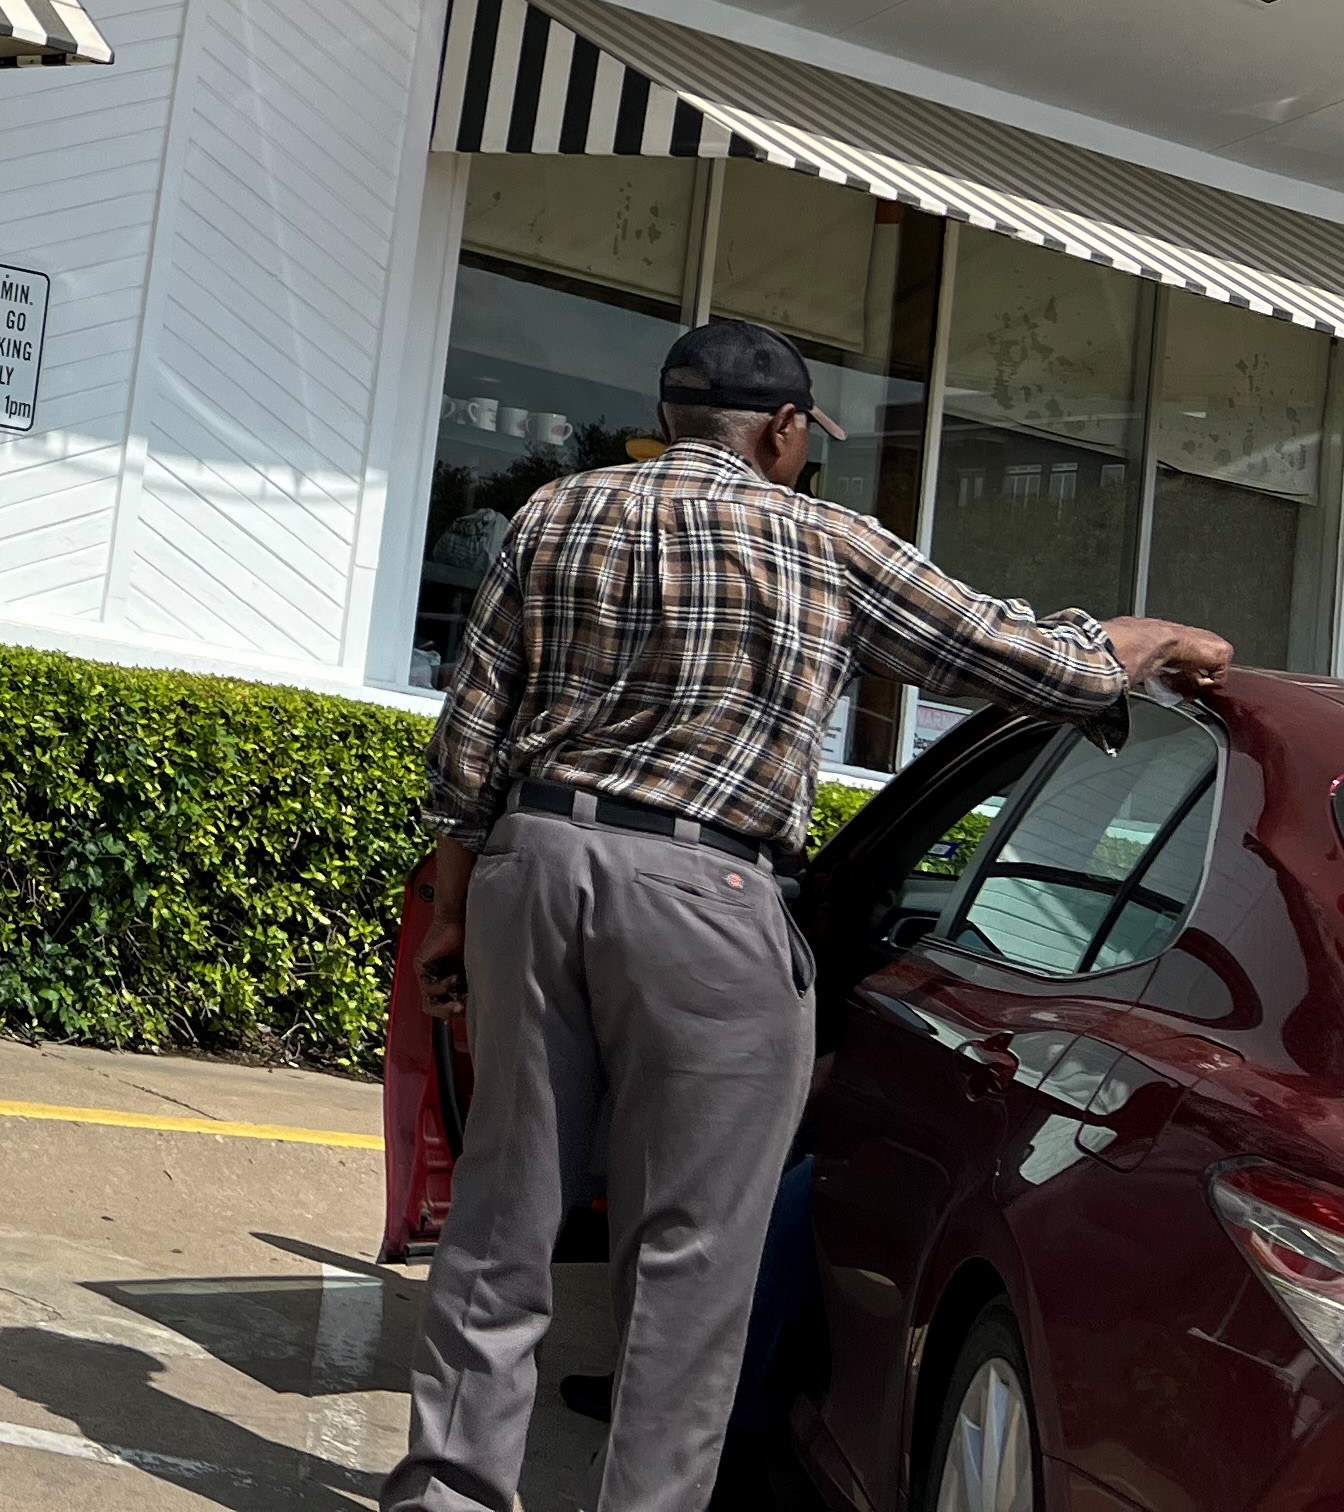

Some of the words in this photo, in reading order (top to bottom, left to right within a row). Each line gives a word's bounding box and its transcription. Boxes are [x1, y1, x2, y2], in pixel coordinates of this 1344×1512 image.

[0, 280, 34, 306] MIN.
[6, 310, 26, 332] GO
[5, 395, 32, 419] 1pm
